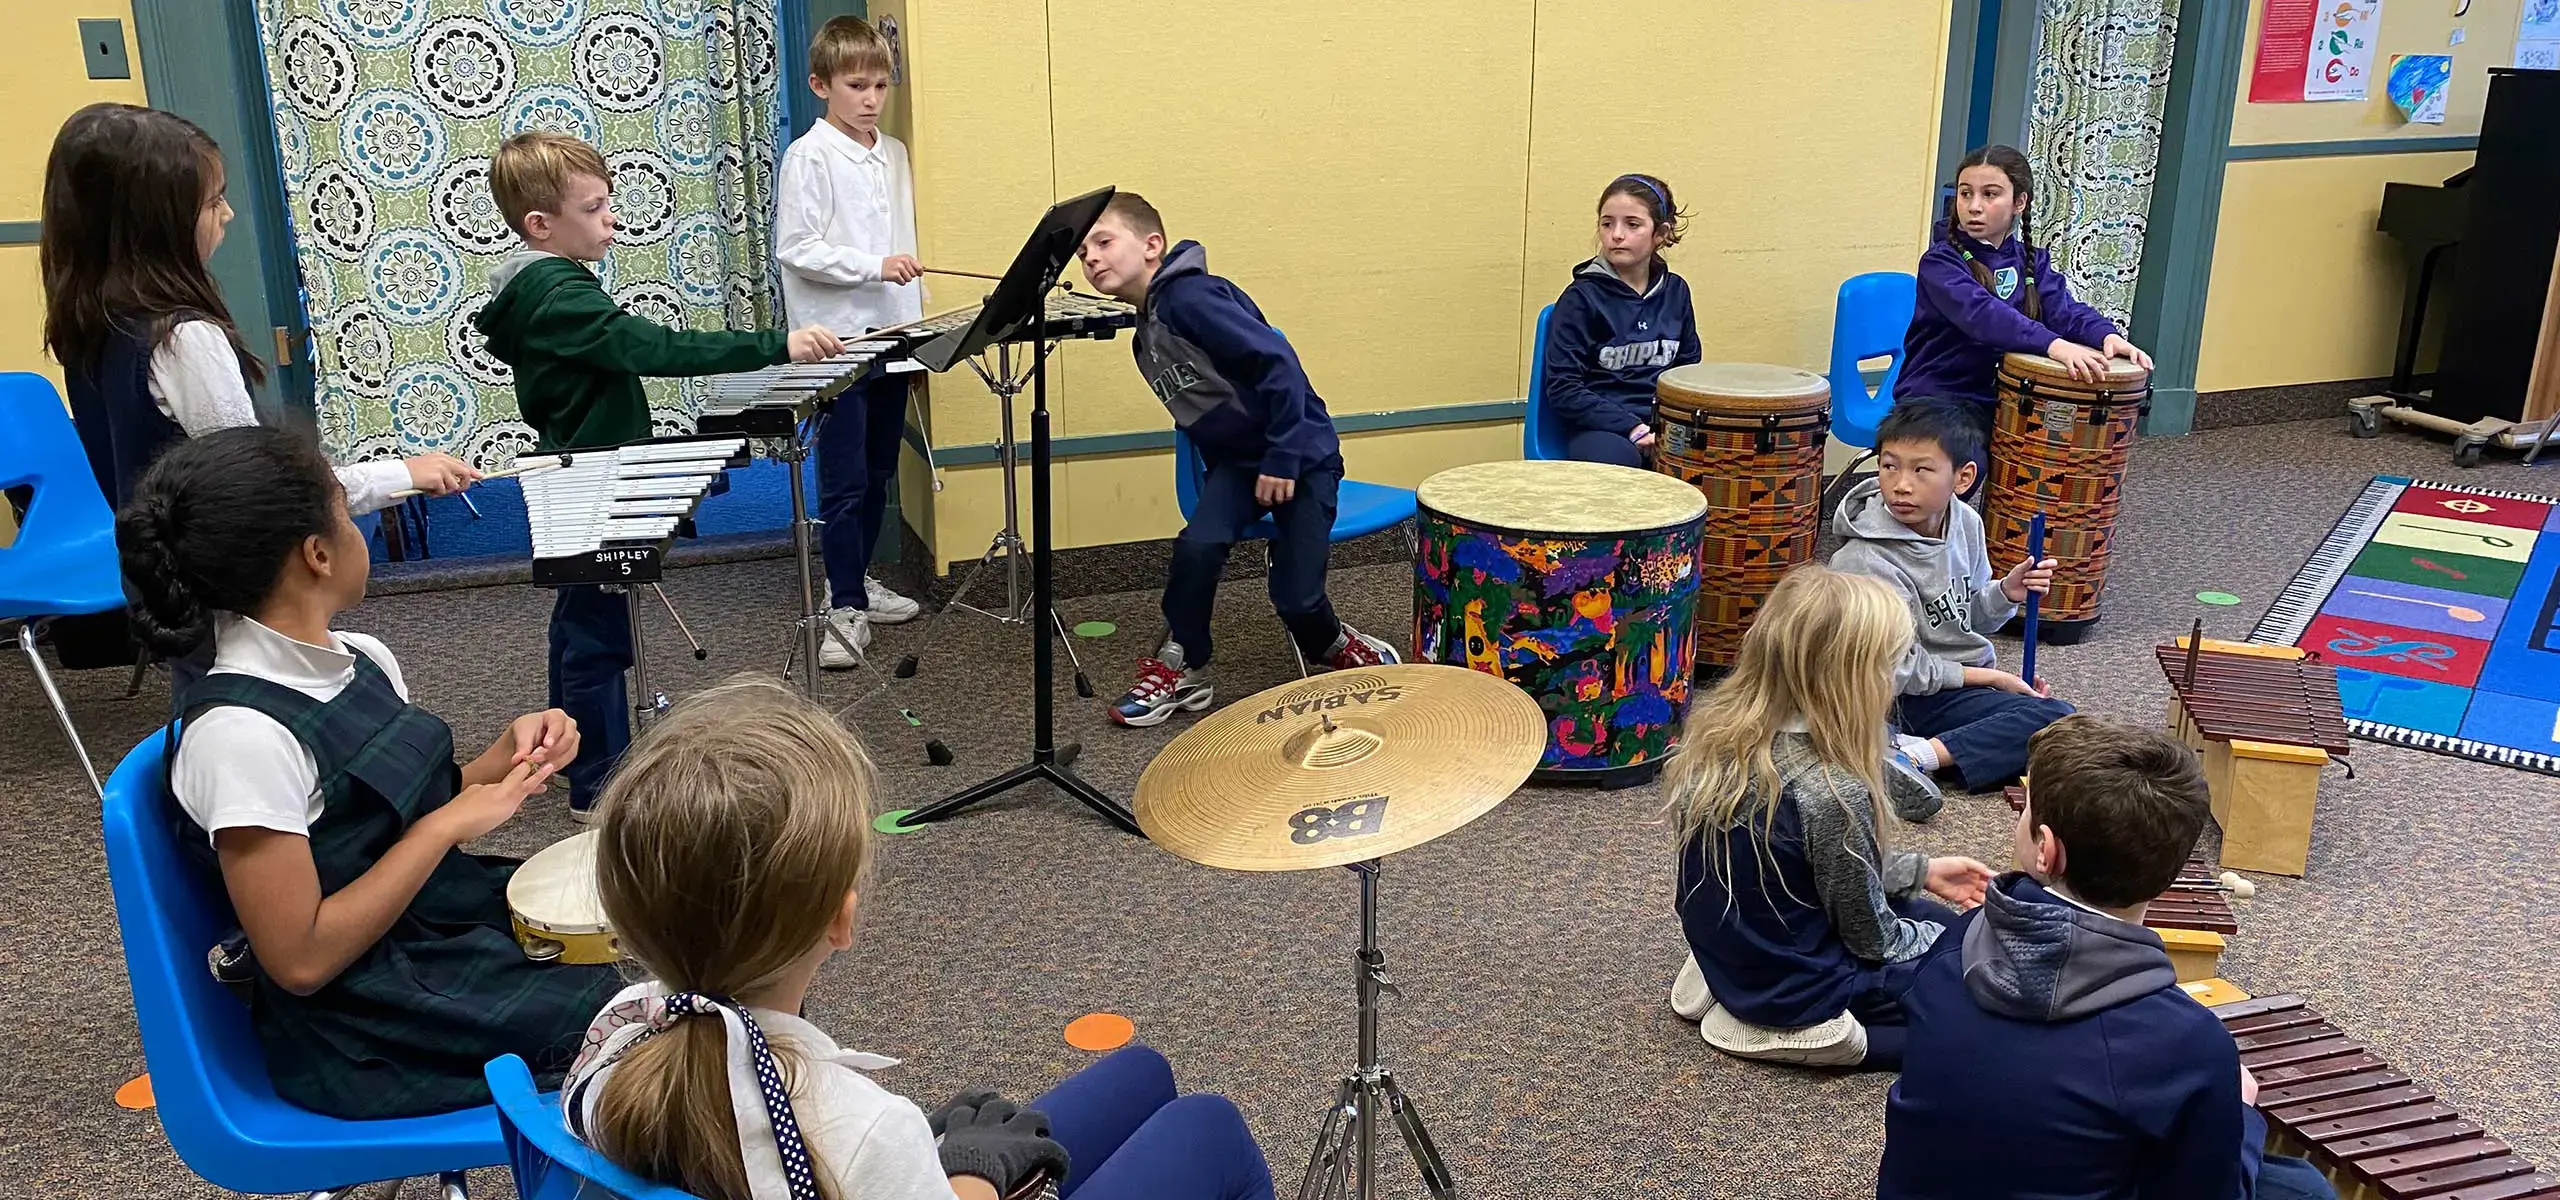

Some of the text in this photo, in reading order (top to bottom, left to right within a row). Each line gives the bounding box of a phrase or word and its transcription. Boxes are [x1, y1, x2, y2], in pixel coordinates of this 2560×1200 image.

[1598, 339, 1681, 371] SHIPLE
[595, 550, 649, 562] SHIPLEY
[621, 562, 631, 575] 5
[1256, 686, 1402, 725] SABIAN
[1288, 796, 1390, 845] B8
